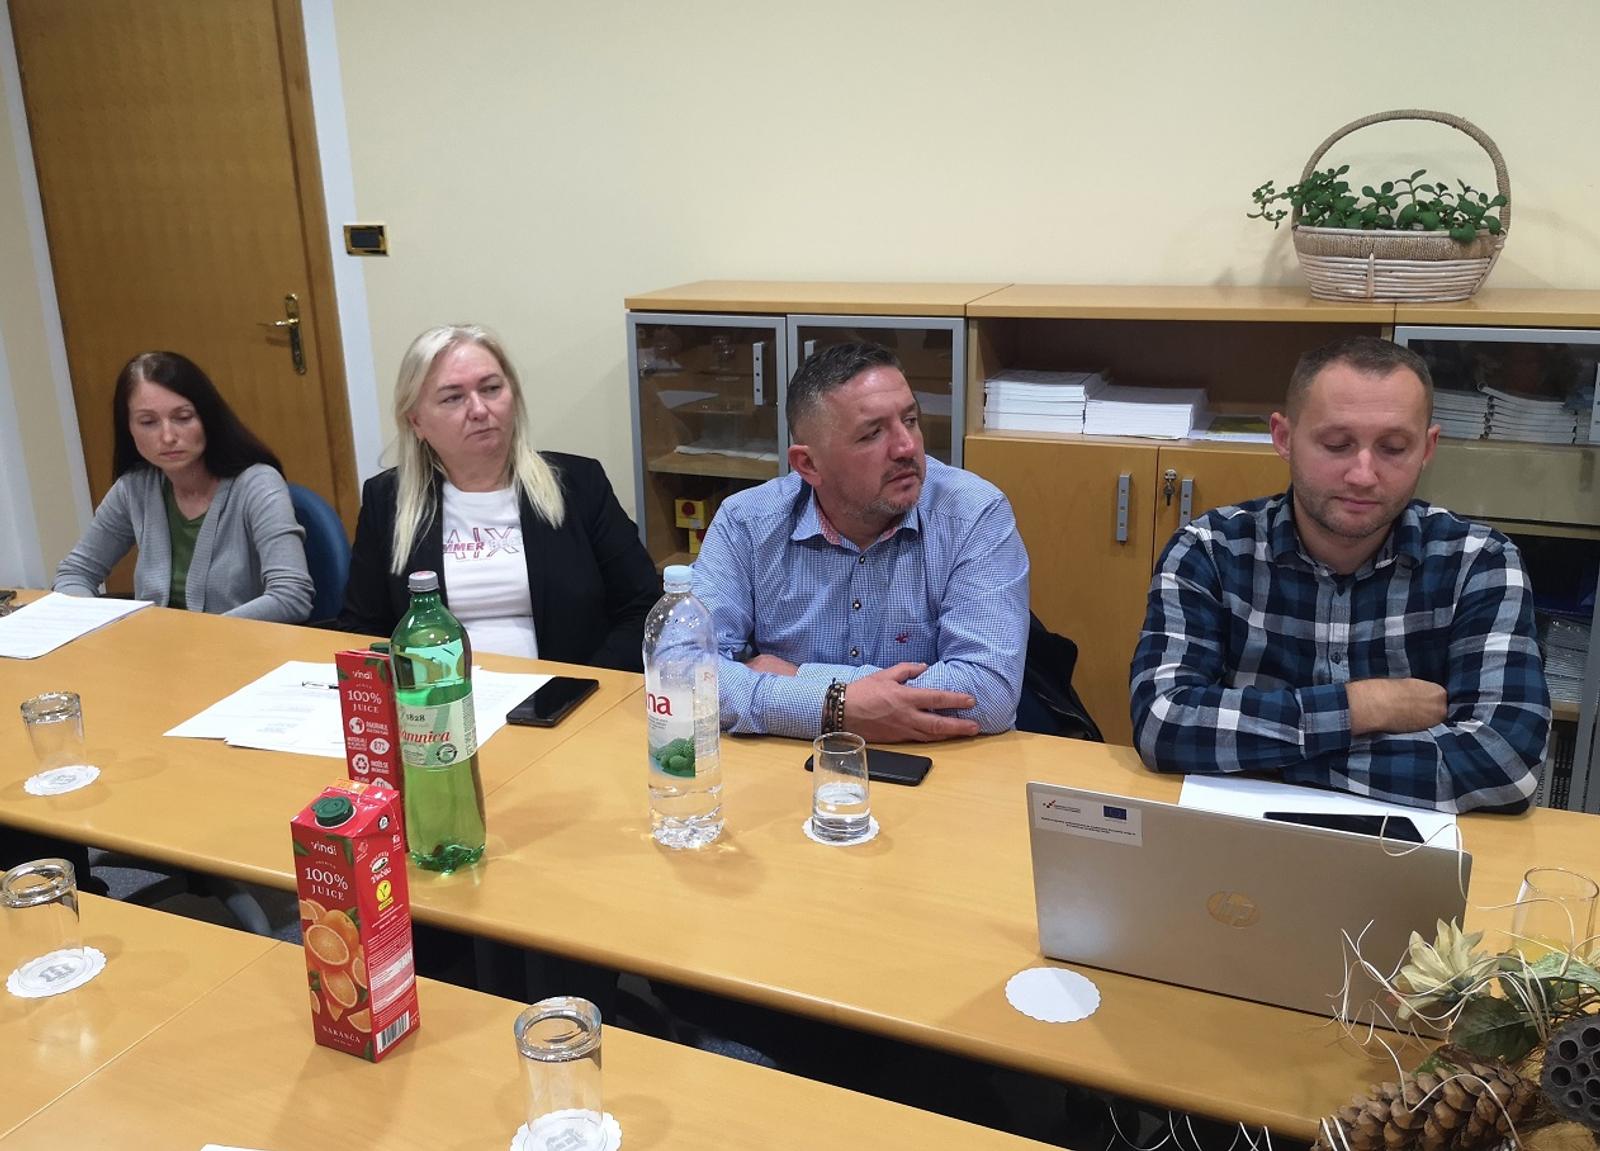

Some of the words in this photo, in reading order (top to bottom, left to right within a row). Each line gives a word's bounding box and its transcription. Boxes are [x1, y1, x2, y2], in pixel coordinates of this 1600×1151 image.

[347, 690, 382, 705] 100%
[646, 693, 673, 716] na
[352, 703, 379, 713] JUICE
[305, 867, 349, 890] 100%
[312, 884, 345, 901] JUICE
